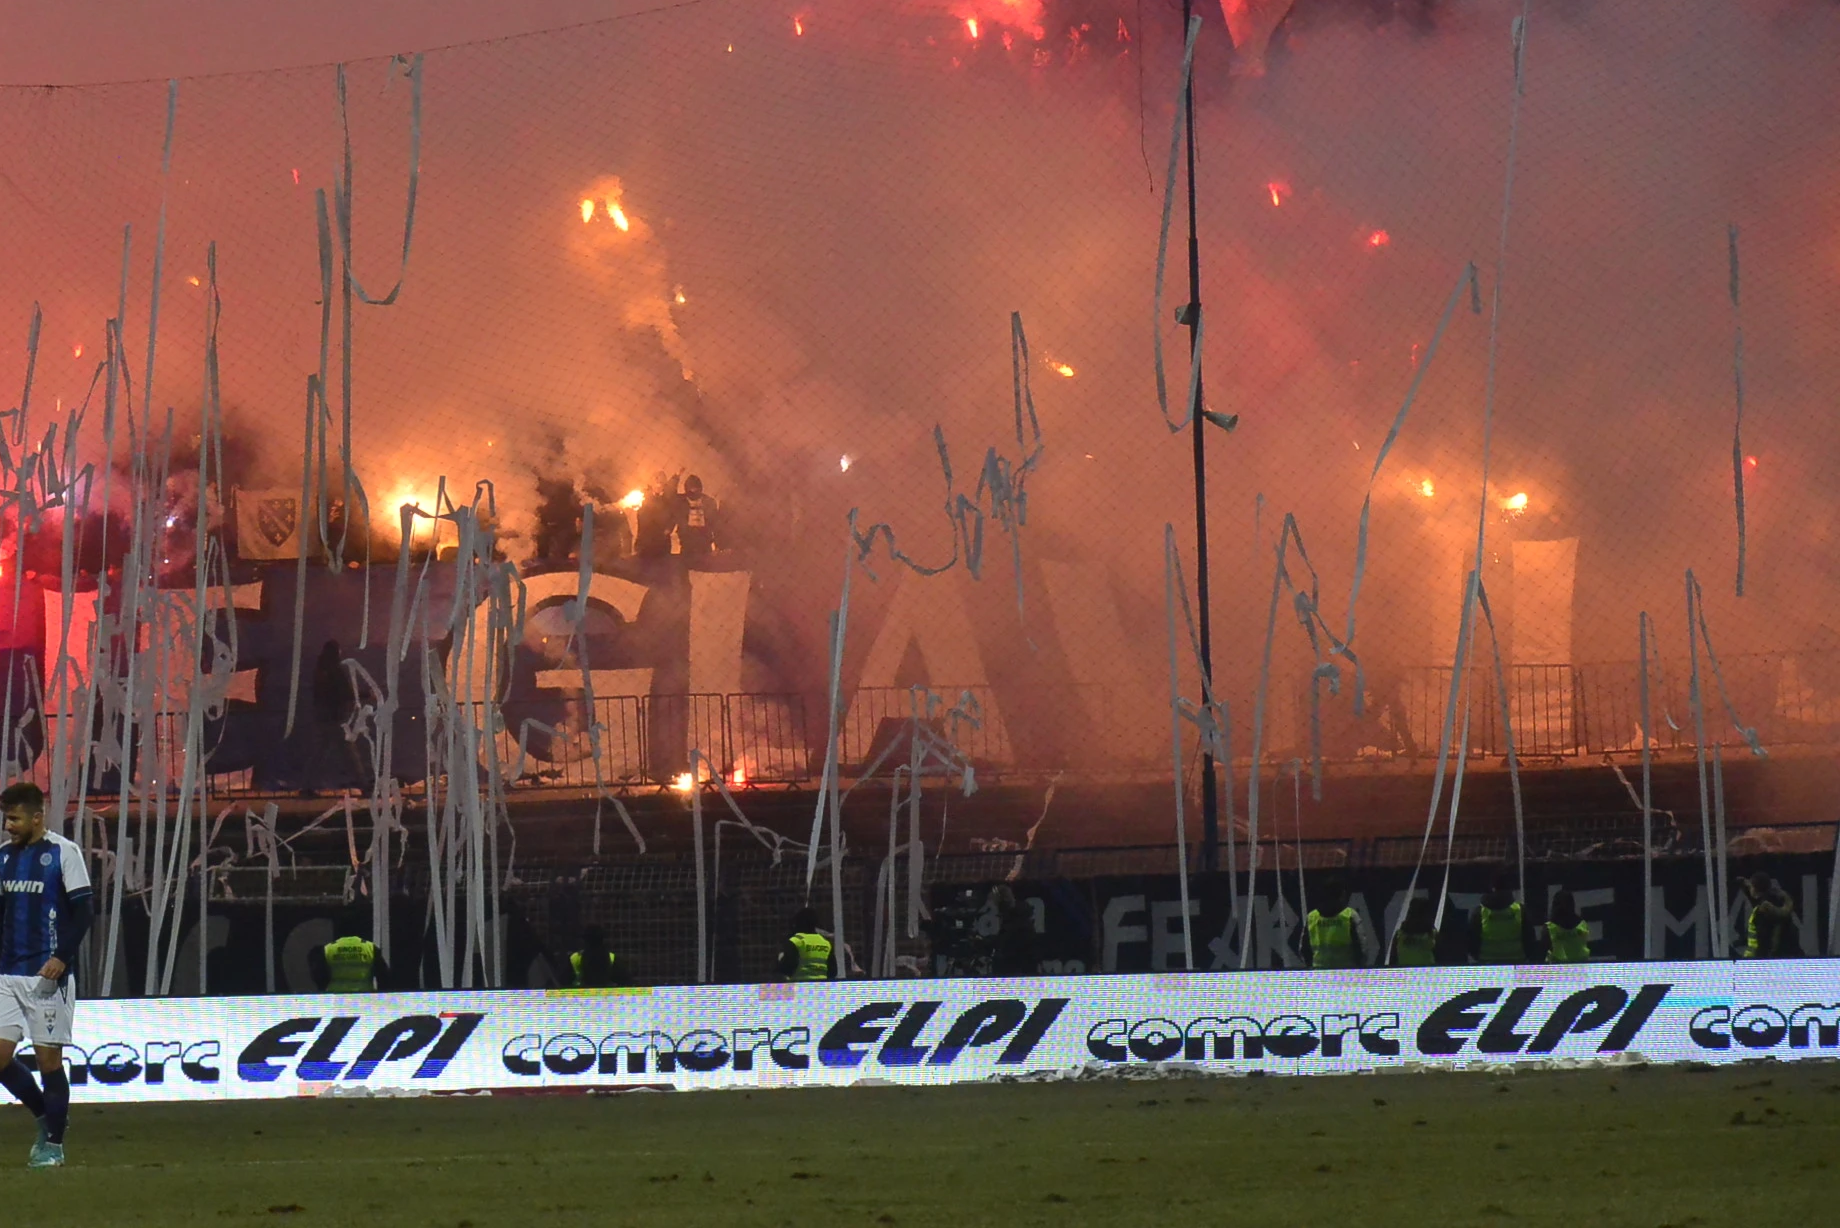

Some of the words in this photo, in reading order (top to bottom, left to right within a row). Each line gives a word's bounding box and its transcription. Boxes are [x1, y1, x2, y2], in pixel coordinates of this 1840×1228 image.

[237, 1012, 488, 1082] ELPI
[502, 1026, 810, 1076] comerc
[817, 998, 1071, 1068] ELPI
[1086, 1012, 1400, 1063] comerc
[1416, 984, 1675, 1055] ELPI
